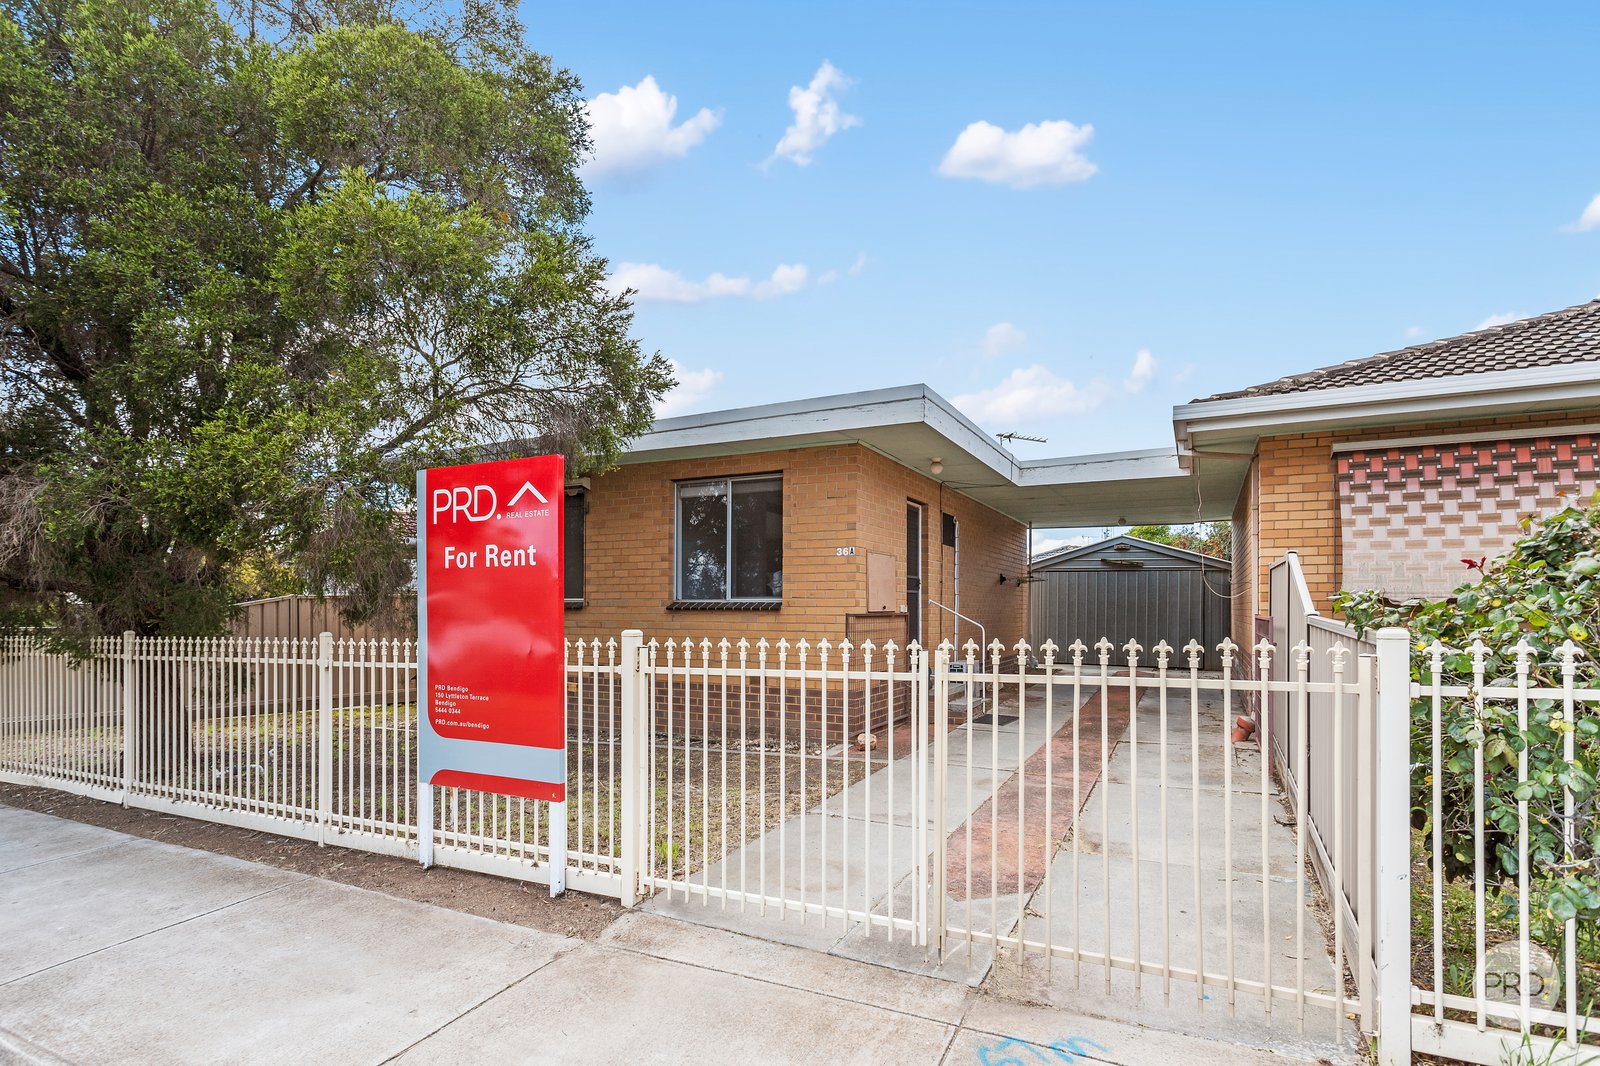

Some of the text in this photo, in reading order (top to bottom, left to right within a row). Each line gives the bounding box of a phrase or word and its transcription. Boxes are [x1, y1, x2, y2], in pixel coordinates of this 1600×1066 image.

[433, 485, 502, 525] PRD.
[506, 509, 549, 519] REAL ESTATE
[836, 546, 855, 556] 36A
[444, 544, 537, 569] For Rent
[446, 685, 469, 693] Bendigo
[435, 699, 457, 707] Bendigo
[435, 719, 490, 729] PRD.com.au/bendigo
